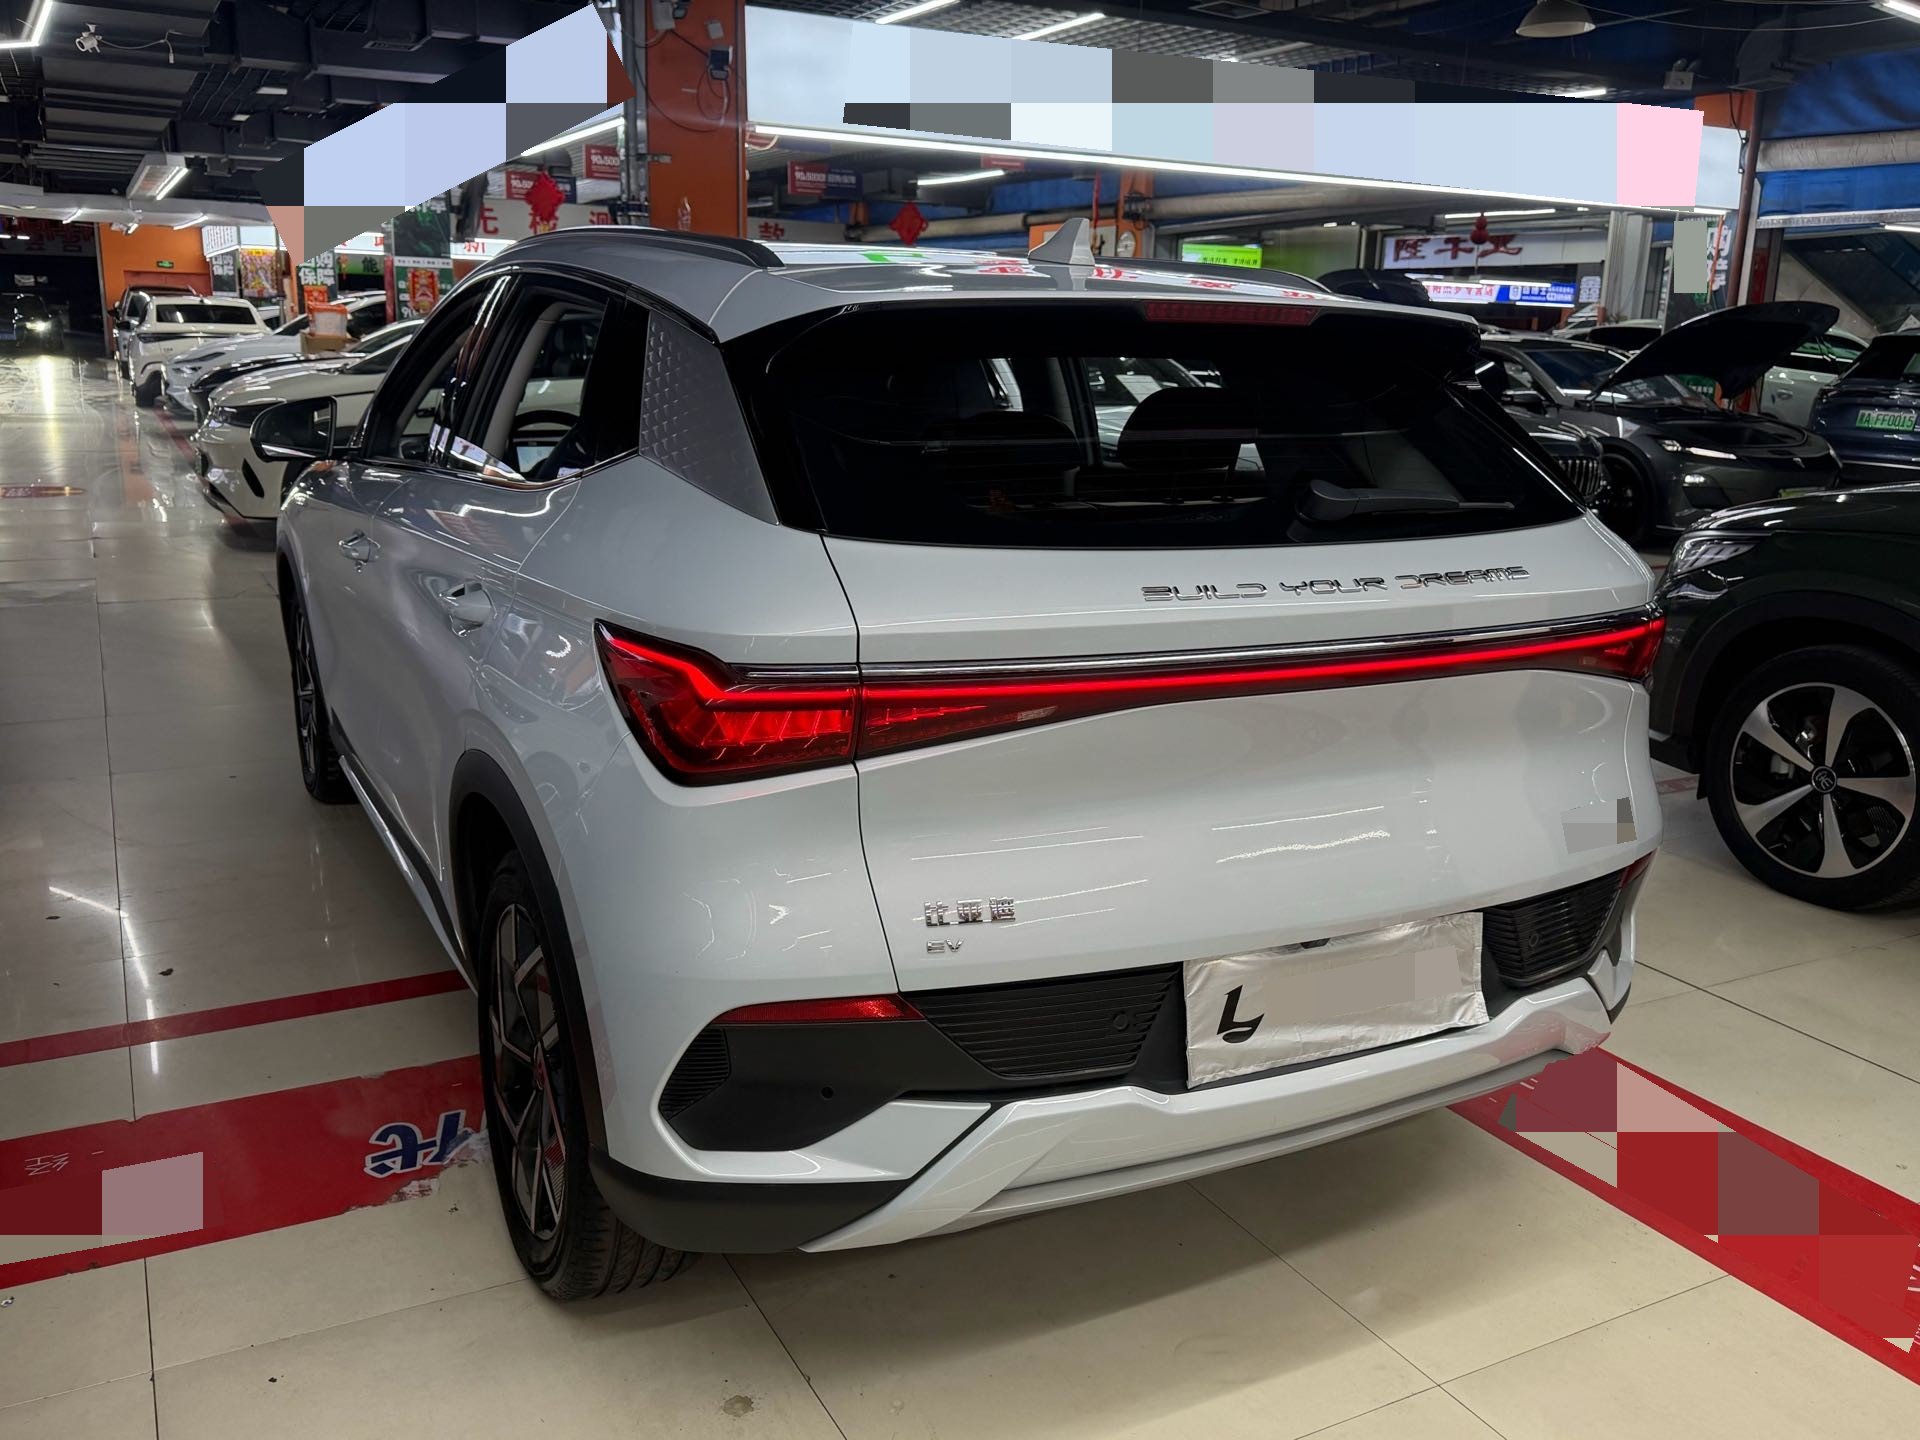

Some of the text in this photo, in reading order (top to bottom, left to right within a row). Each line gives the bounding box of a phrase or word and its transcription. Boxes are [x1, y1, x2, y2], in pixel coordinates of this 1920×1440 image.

[1141, 565, 1532, 602] BUILD YOUR DREAMS
[924, 897, 1016, 927] 比亚迪
[926, 938, 964, 953] EV
